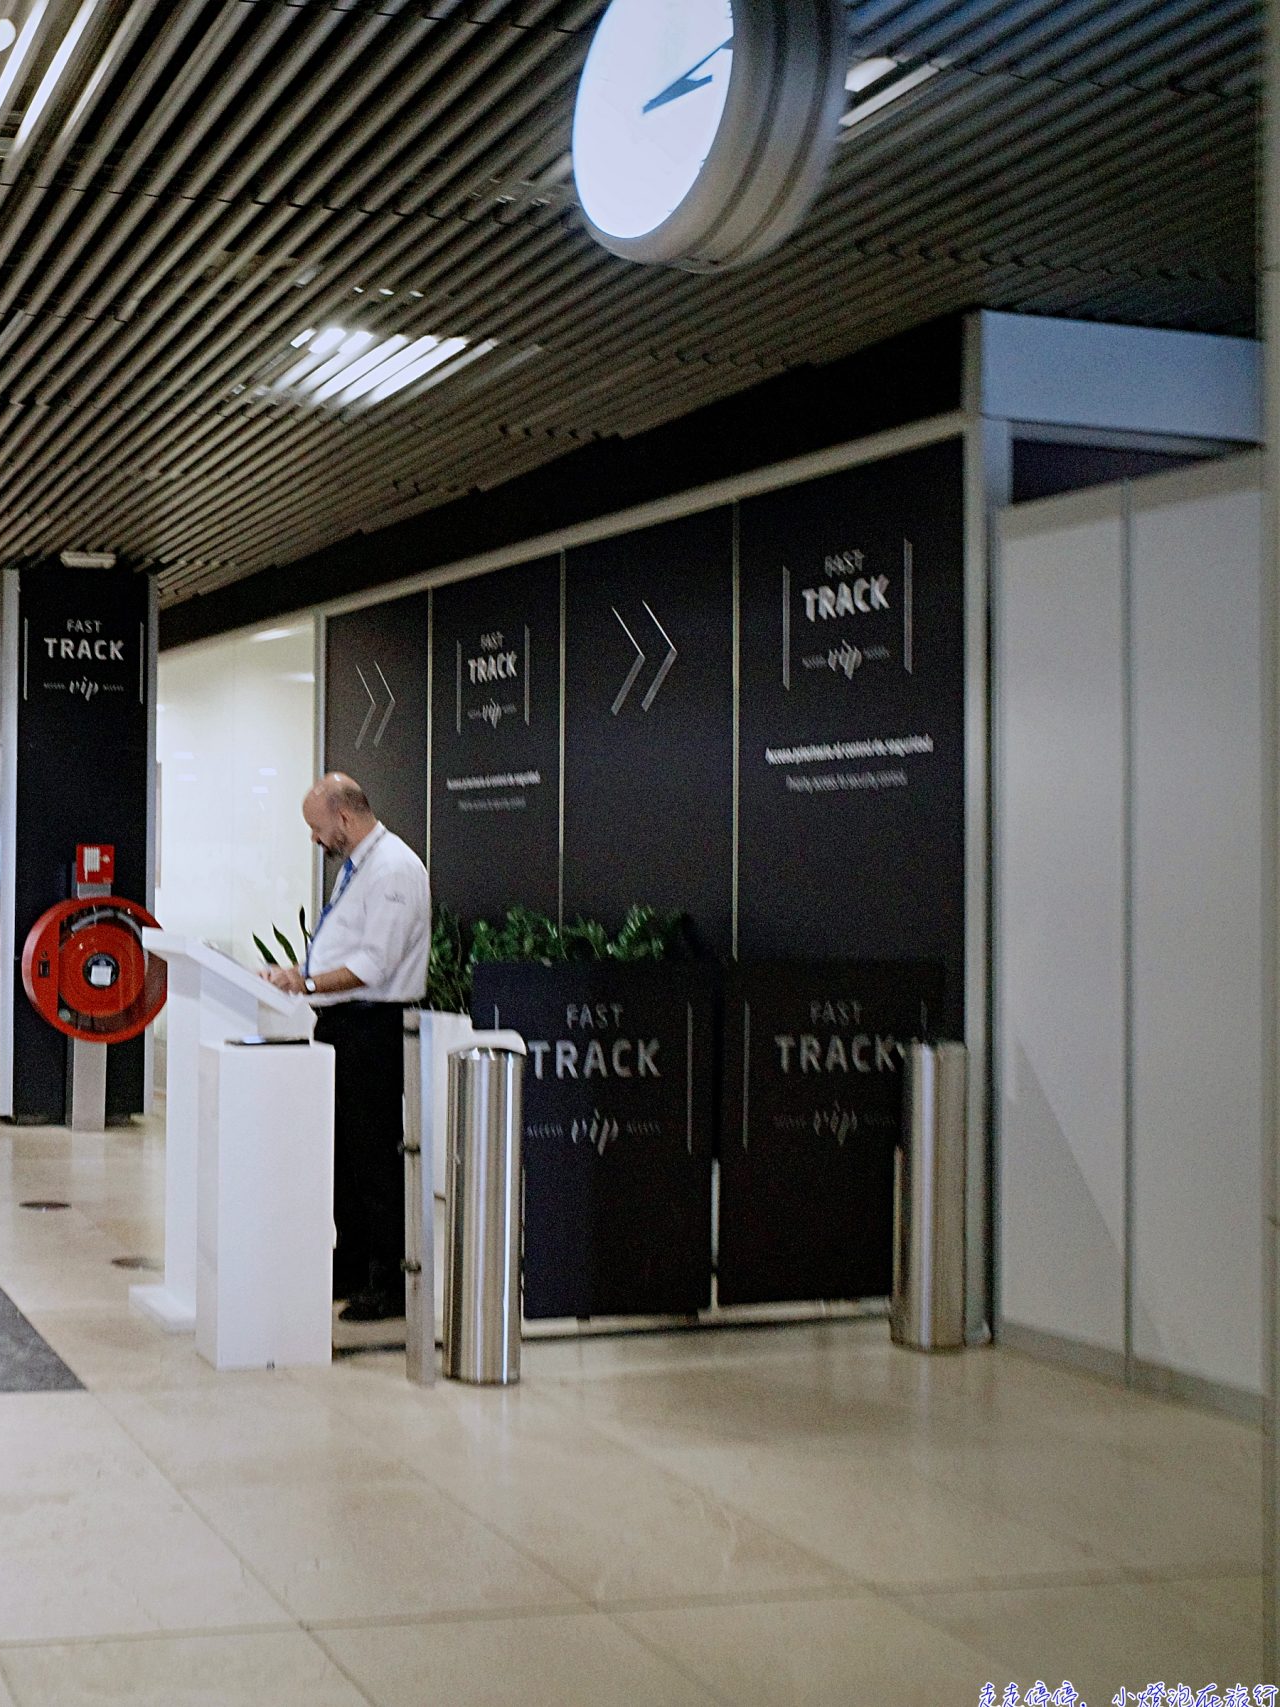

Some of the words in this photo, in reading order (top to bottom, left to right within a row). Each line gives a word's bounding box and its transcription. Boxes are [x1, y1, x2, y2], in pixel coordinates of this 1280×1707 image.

[801, 574, 890, 622] TRACK
[66, 619, 102, 634] FAST
[43, 637, 125, 661] TRACK
[468, 651, 517, 684] TRACK
[566, 1003, 624, 1029] FAST
[527, 1039, 662, 1080] TRACK
[774, 1034, 896, 1073] TRACK
